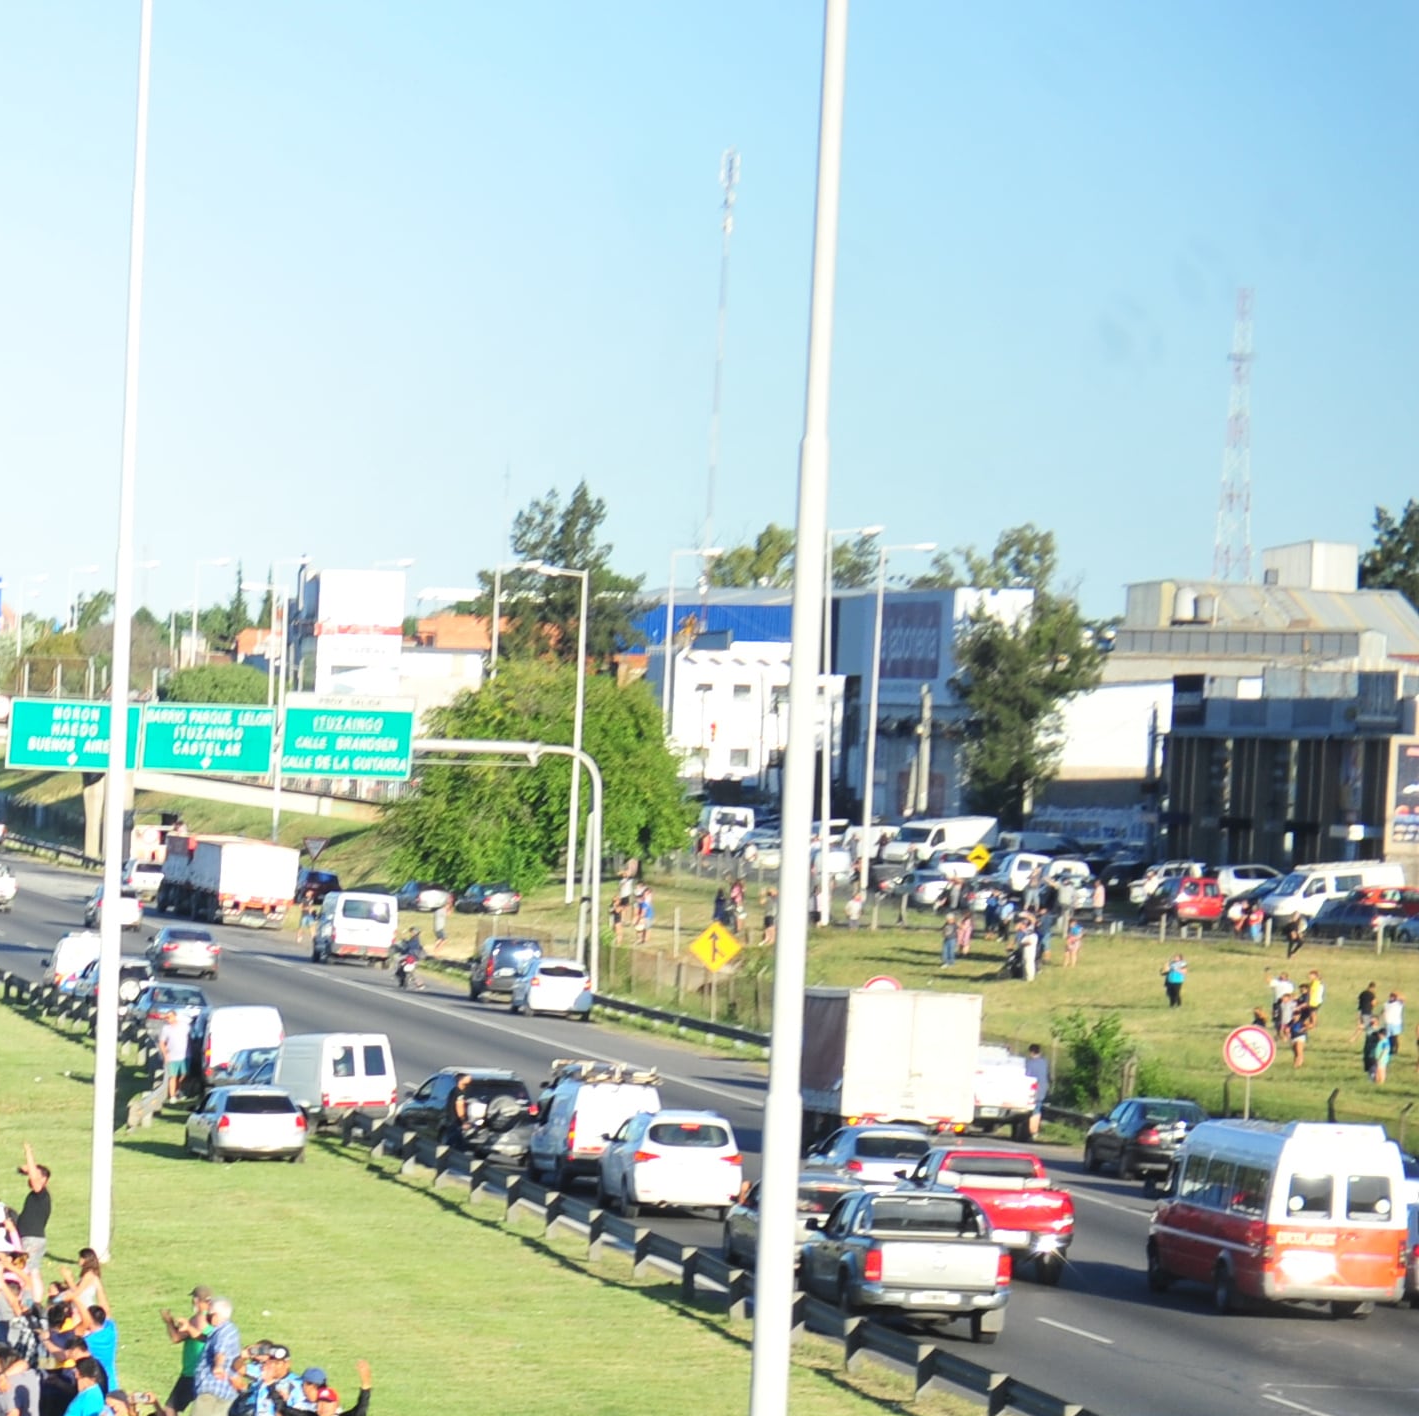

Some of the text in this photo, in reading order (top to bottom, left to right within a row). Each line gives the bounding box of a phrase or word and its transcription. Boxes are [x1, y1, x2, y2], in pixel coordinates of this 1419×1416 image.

[188, 709, 232, 726] PARQUE
[313, 714, 385, 732] ITUZAINGO
[173, 724, 245, 740] ITUZAINGO
[26, 735, 76, 752] BUENOS
[172, 740, 242, 757] CASTELAR
